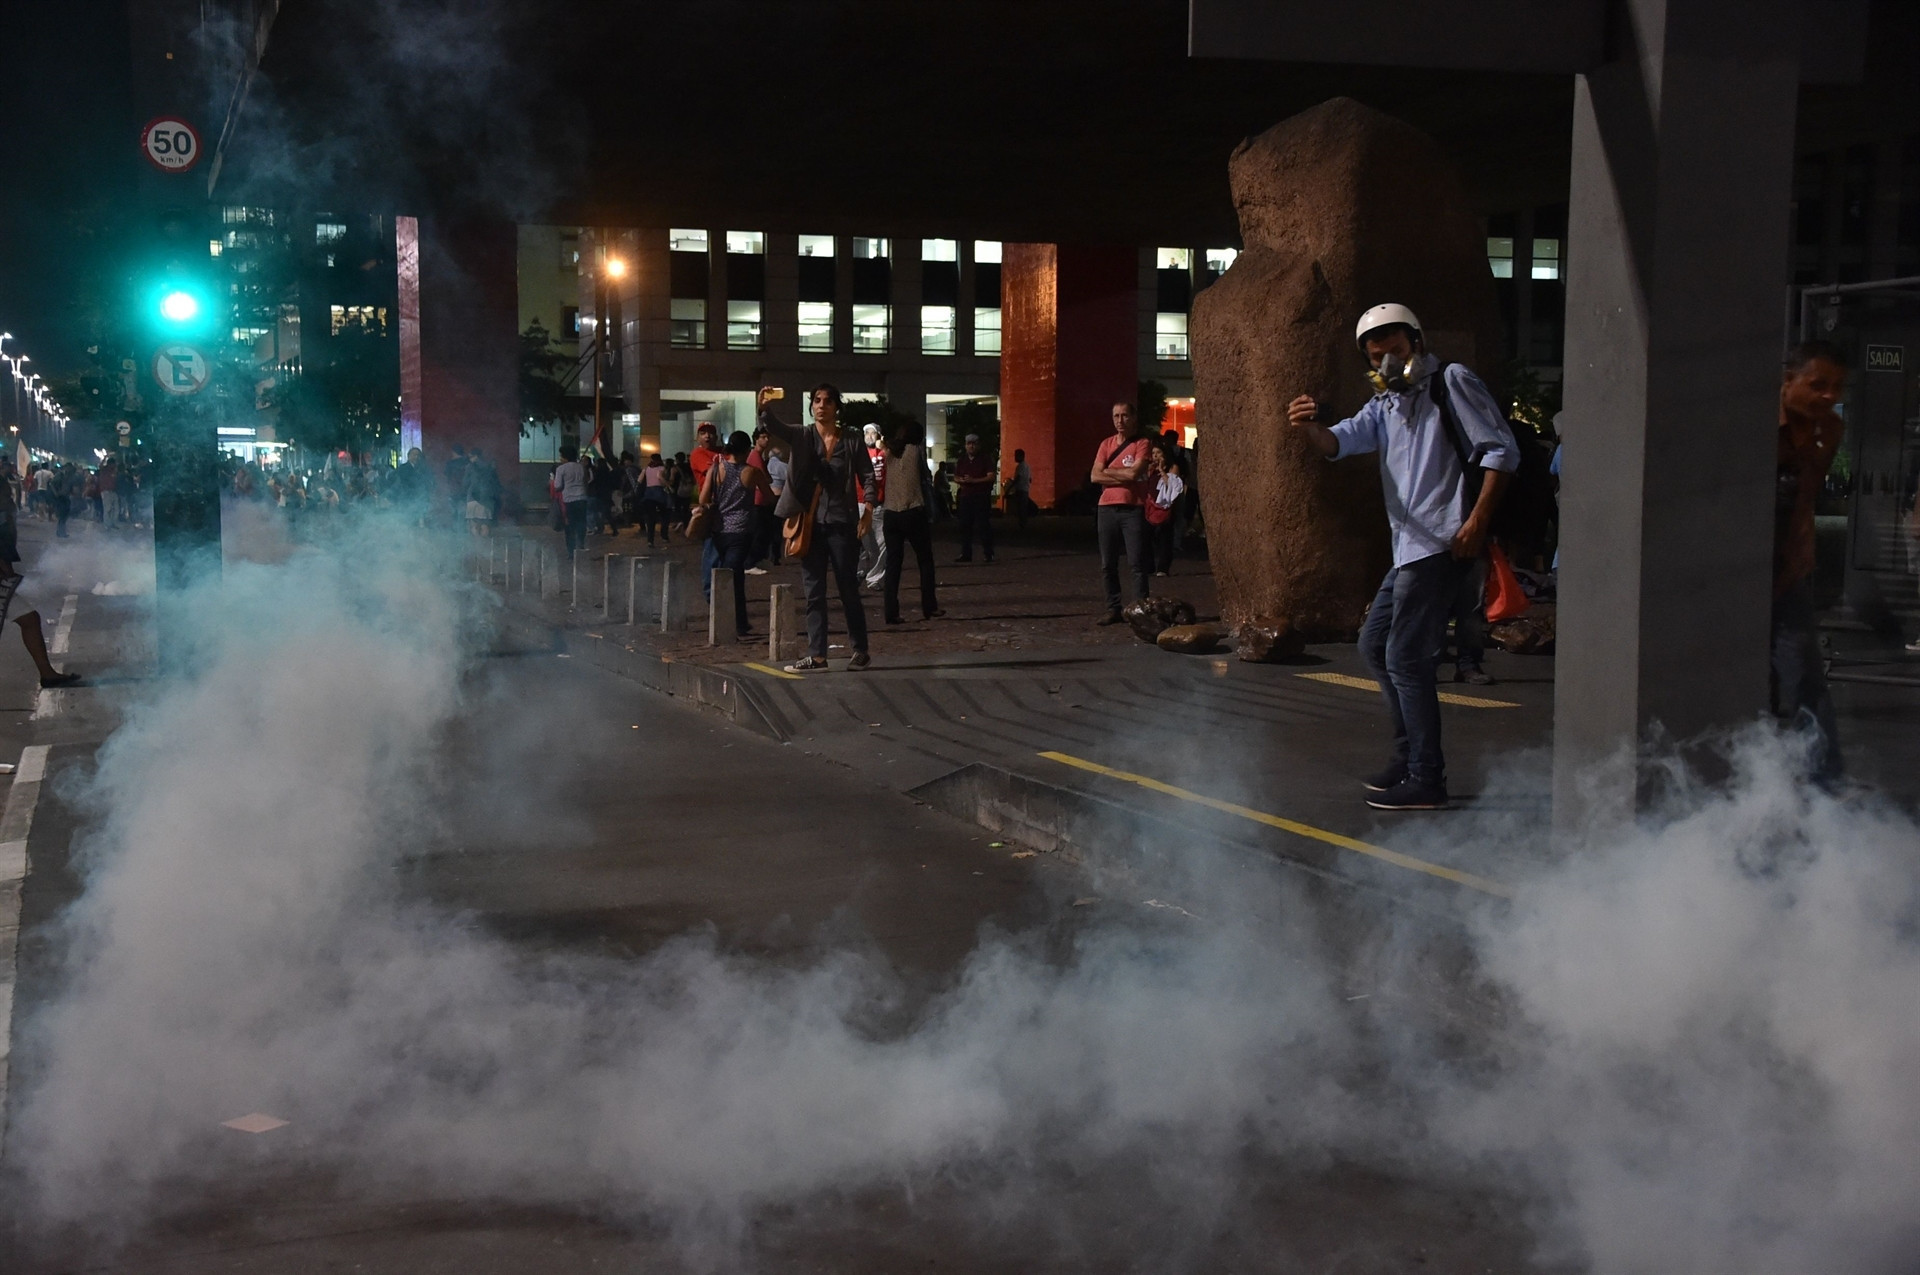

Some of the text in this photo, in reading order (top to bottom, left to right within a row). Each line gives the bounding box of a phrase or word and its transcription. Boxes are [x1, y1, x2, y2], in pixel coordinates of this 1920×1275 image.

[154, 130, 191, 155] 50
[160, 156, 184, 164] km/h
[1870, 348, 1900, 366] SAÍDA
[172, 355, 193, 386] E
